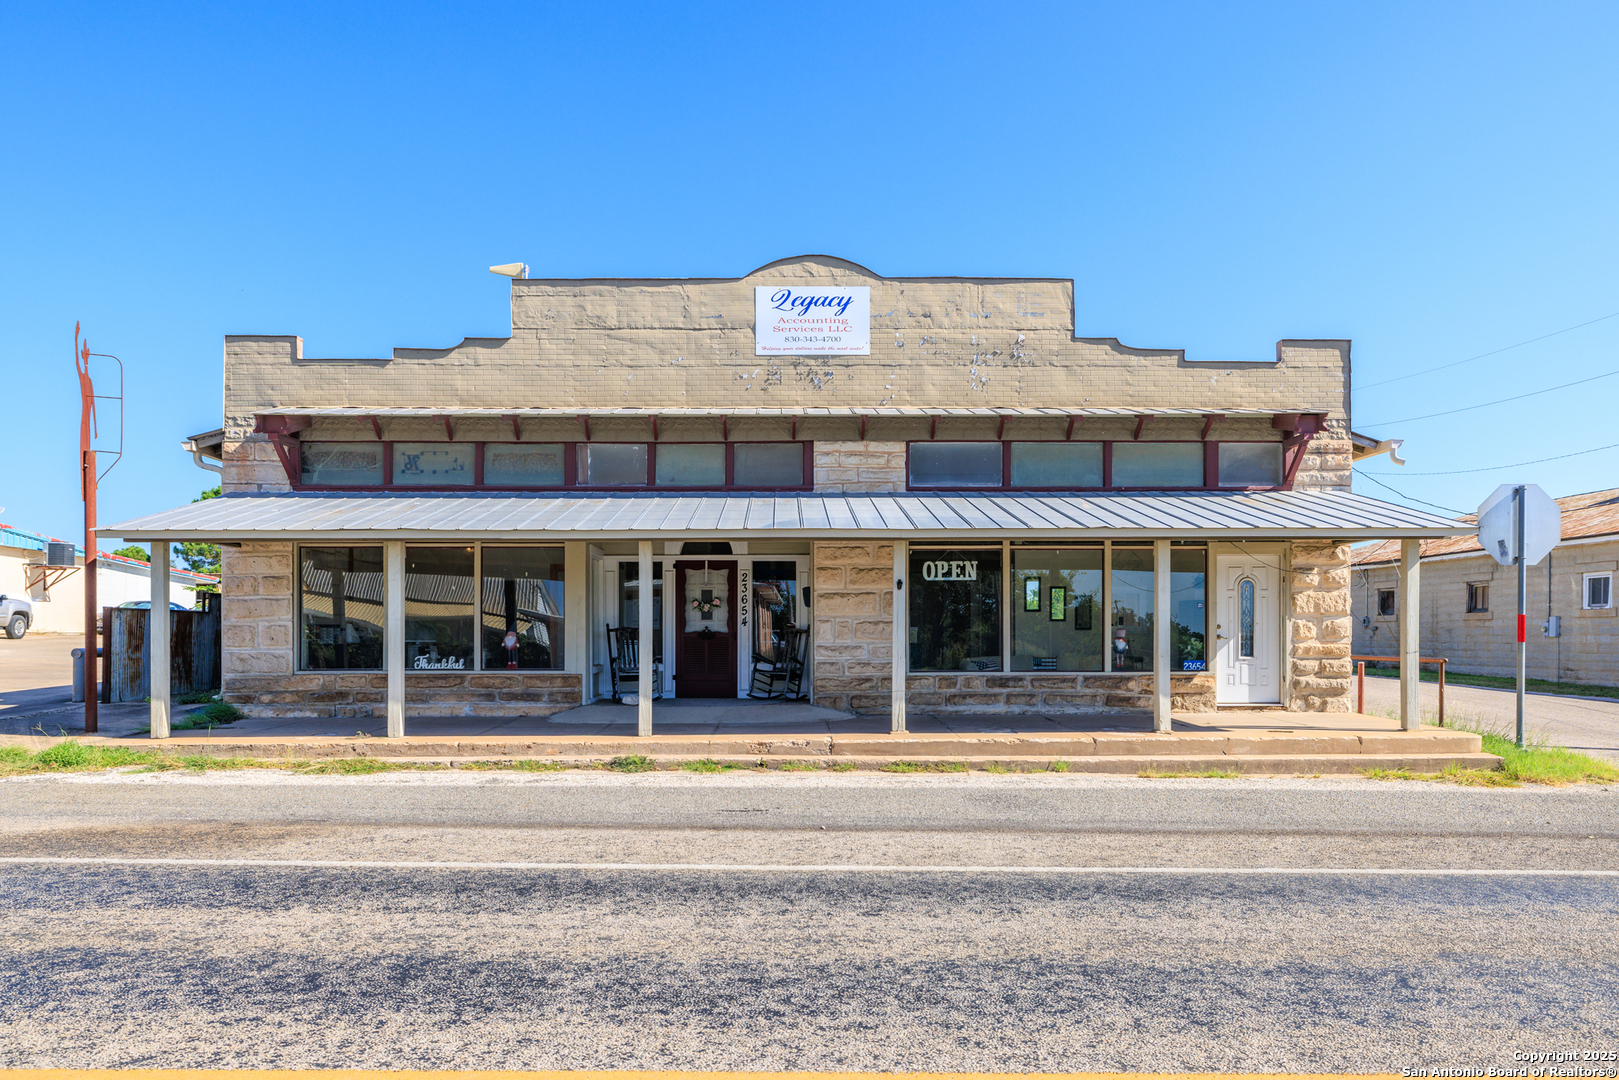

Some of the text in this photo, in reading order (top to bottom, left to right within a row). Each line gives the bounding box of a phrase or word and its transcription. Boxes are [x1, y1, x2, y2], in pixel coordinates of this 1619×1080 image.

[770, 289, 854, 317] Legacy
[777, 317, 849, 325] Accounting
[922, 560, 979, 581] OPEN
[413, 653, 465, 669] Thankful
